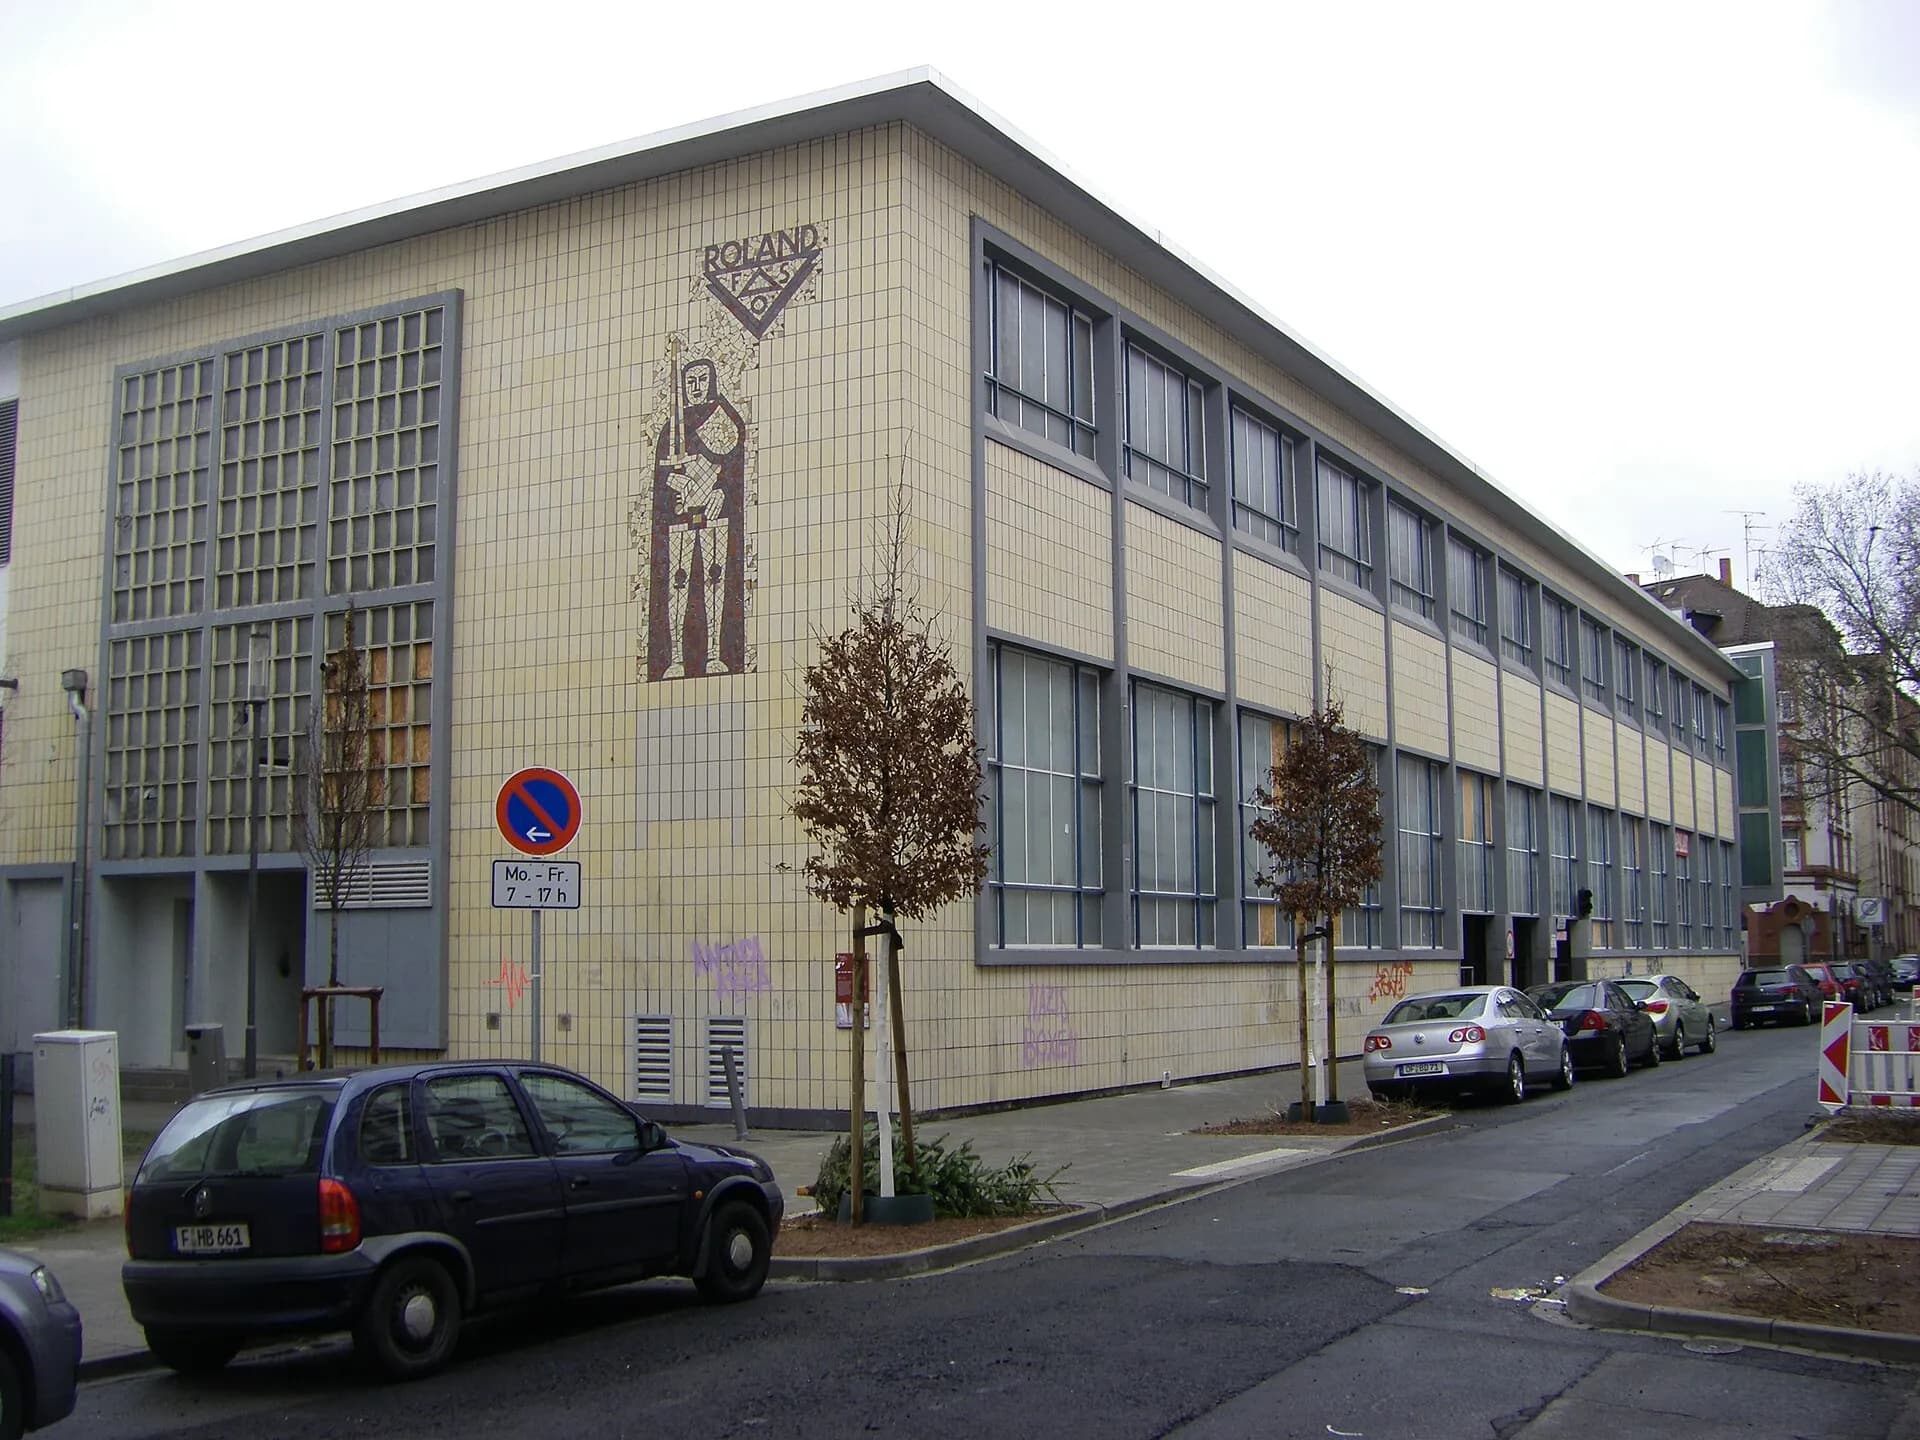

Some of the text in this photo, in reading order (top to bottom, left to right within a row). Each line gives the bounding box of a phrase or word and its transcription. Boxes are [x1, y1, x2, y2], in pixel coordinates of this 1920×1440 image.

[704, 224, 819, 274] ROLAND
[505, 866, 531, 881] Mo.
[548, 867, 568, 882] Fr.
[507, 887, 516, 902] 7
[538, 888, 552, 902] 17
[557, 888, 567, 903] h
